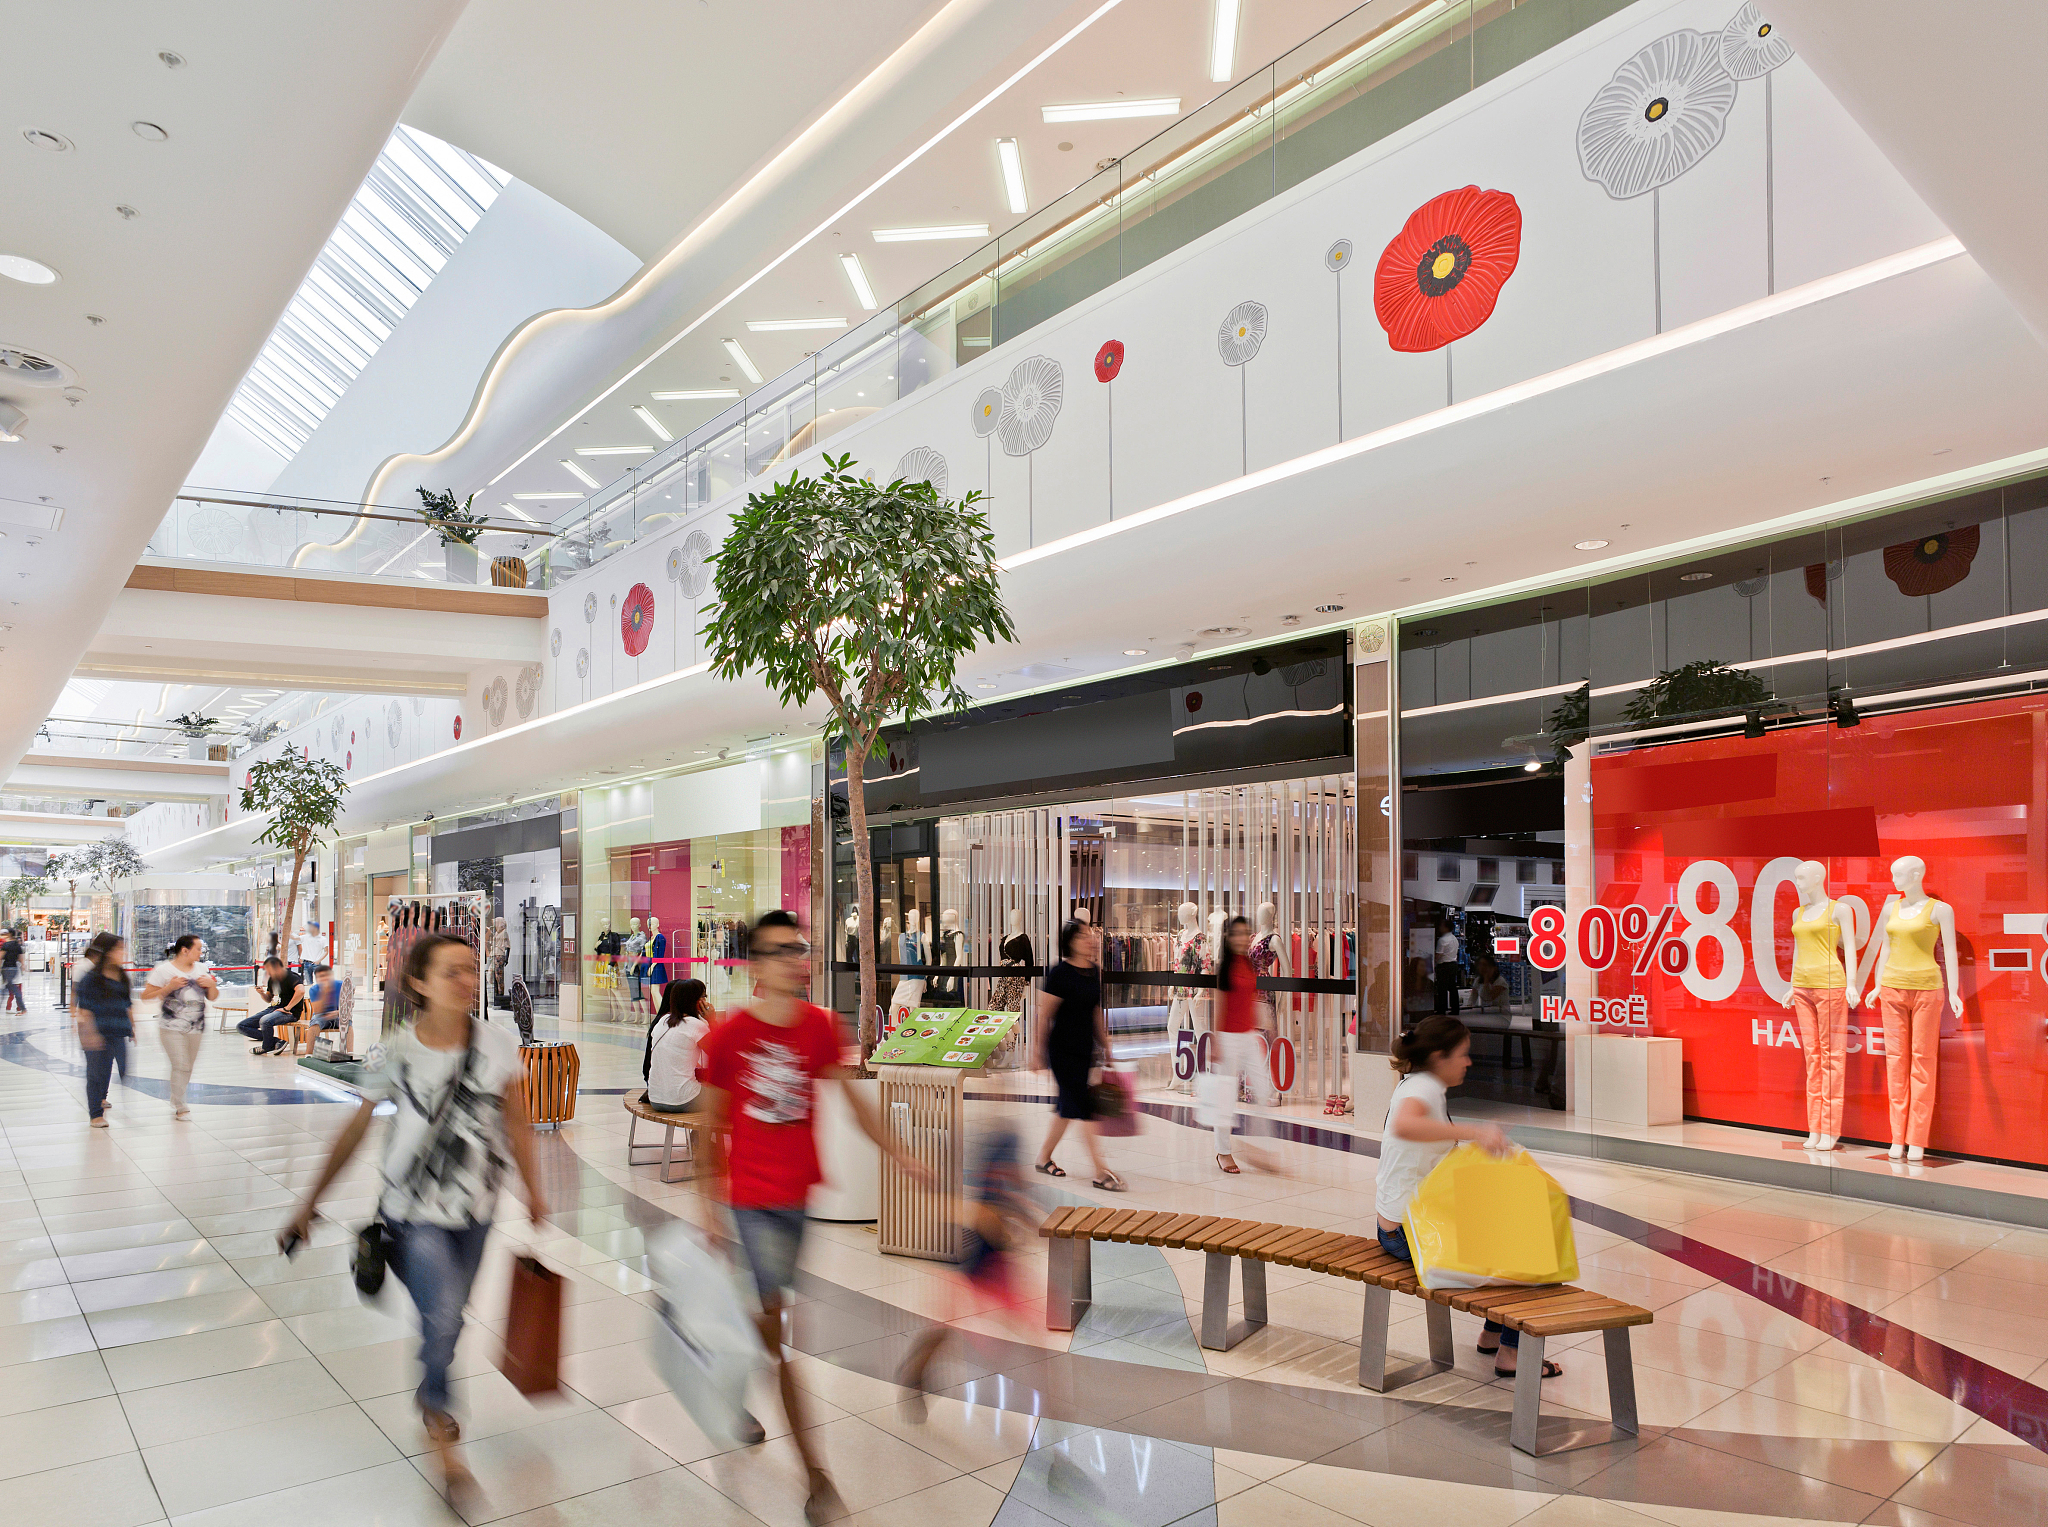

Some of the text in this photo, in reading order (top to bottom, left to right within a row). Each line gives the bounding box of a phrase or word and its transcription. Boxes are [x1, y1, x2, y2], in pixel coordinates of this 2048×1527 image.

[1494, 904, 1691, 976] -80%
[1540, 995, 1648, 1027] НА ВСЁ
[1752, 1019, 1801, 1049] НА
